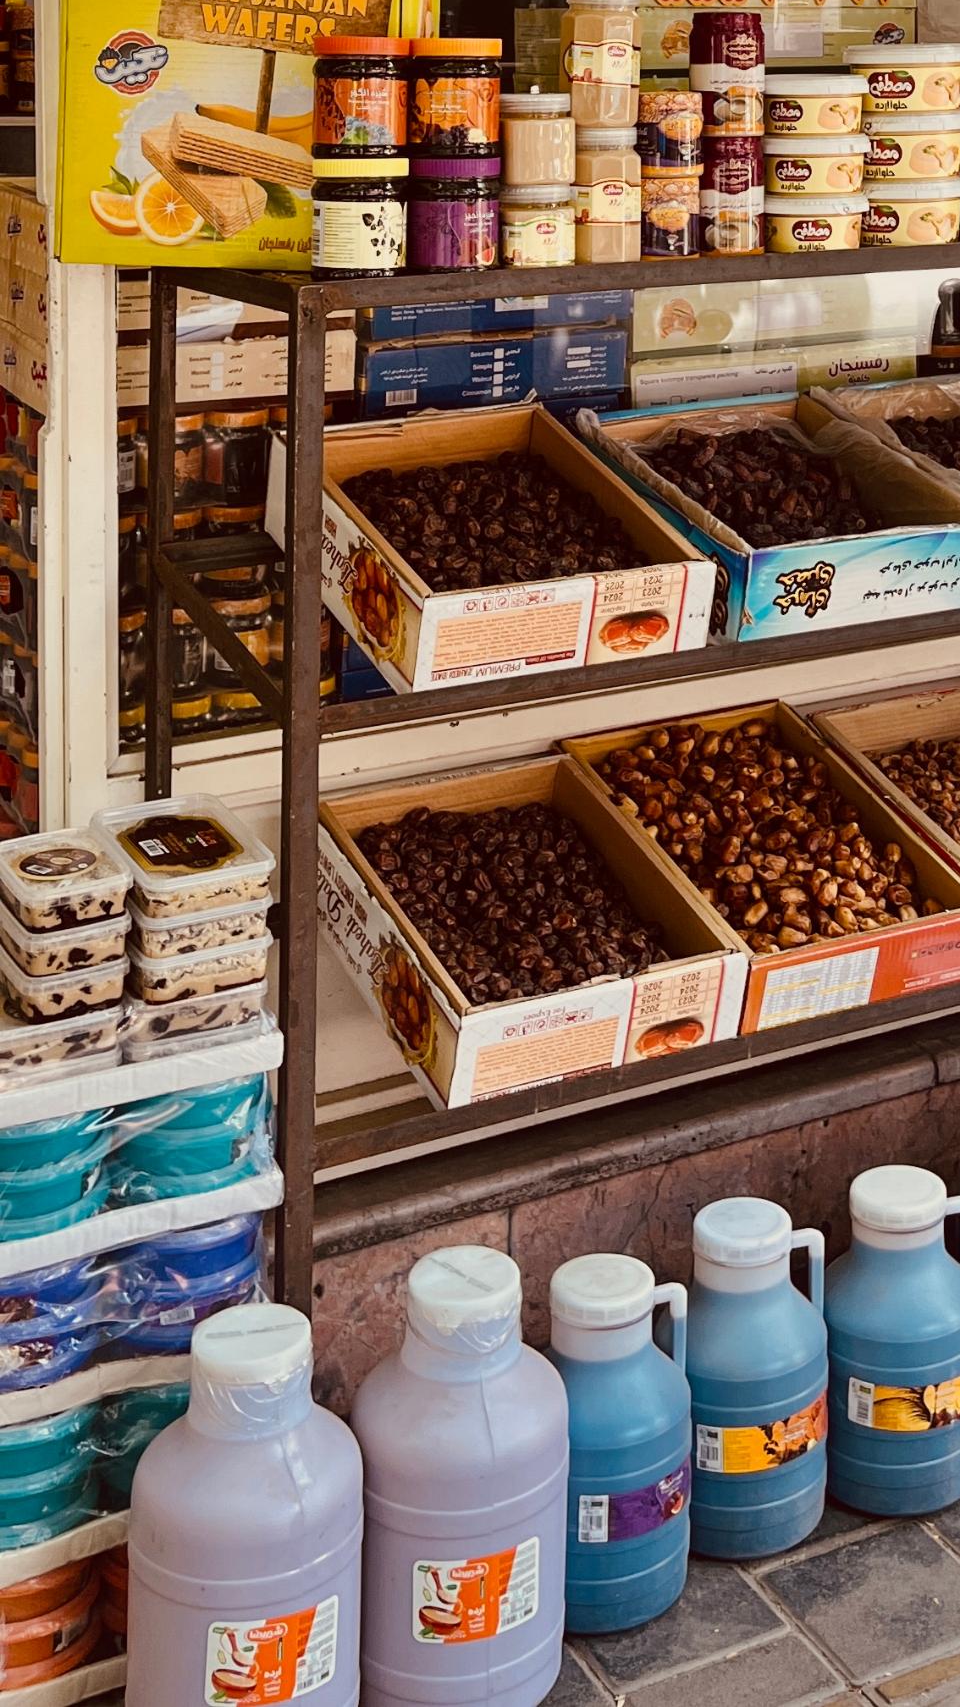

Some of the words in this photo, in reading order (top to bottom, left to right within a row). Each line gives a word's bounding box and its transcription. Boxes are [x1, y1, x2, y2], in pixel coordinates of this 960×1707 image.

[201, 4, 338, 46] WAFERS
[828, 355, 890, 375] رفسنجان
[879, 560, 912, 576] خرمای
[475, 661, 522, 678] PREMIUM
